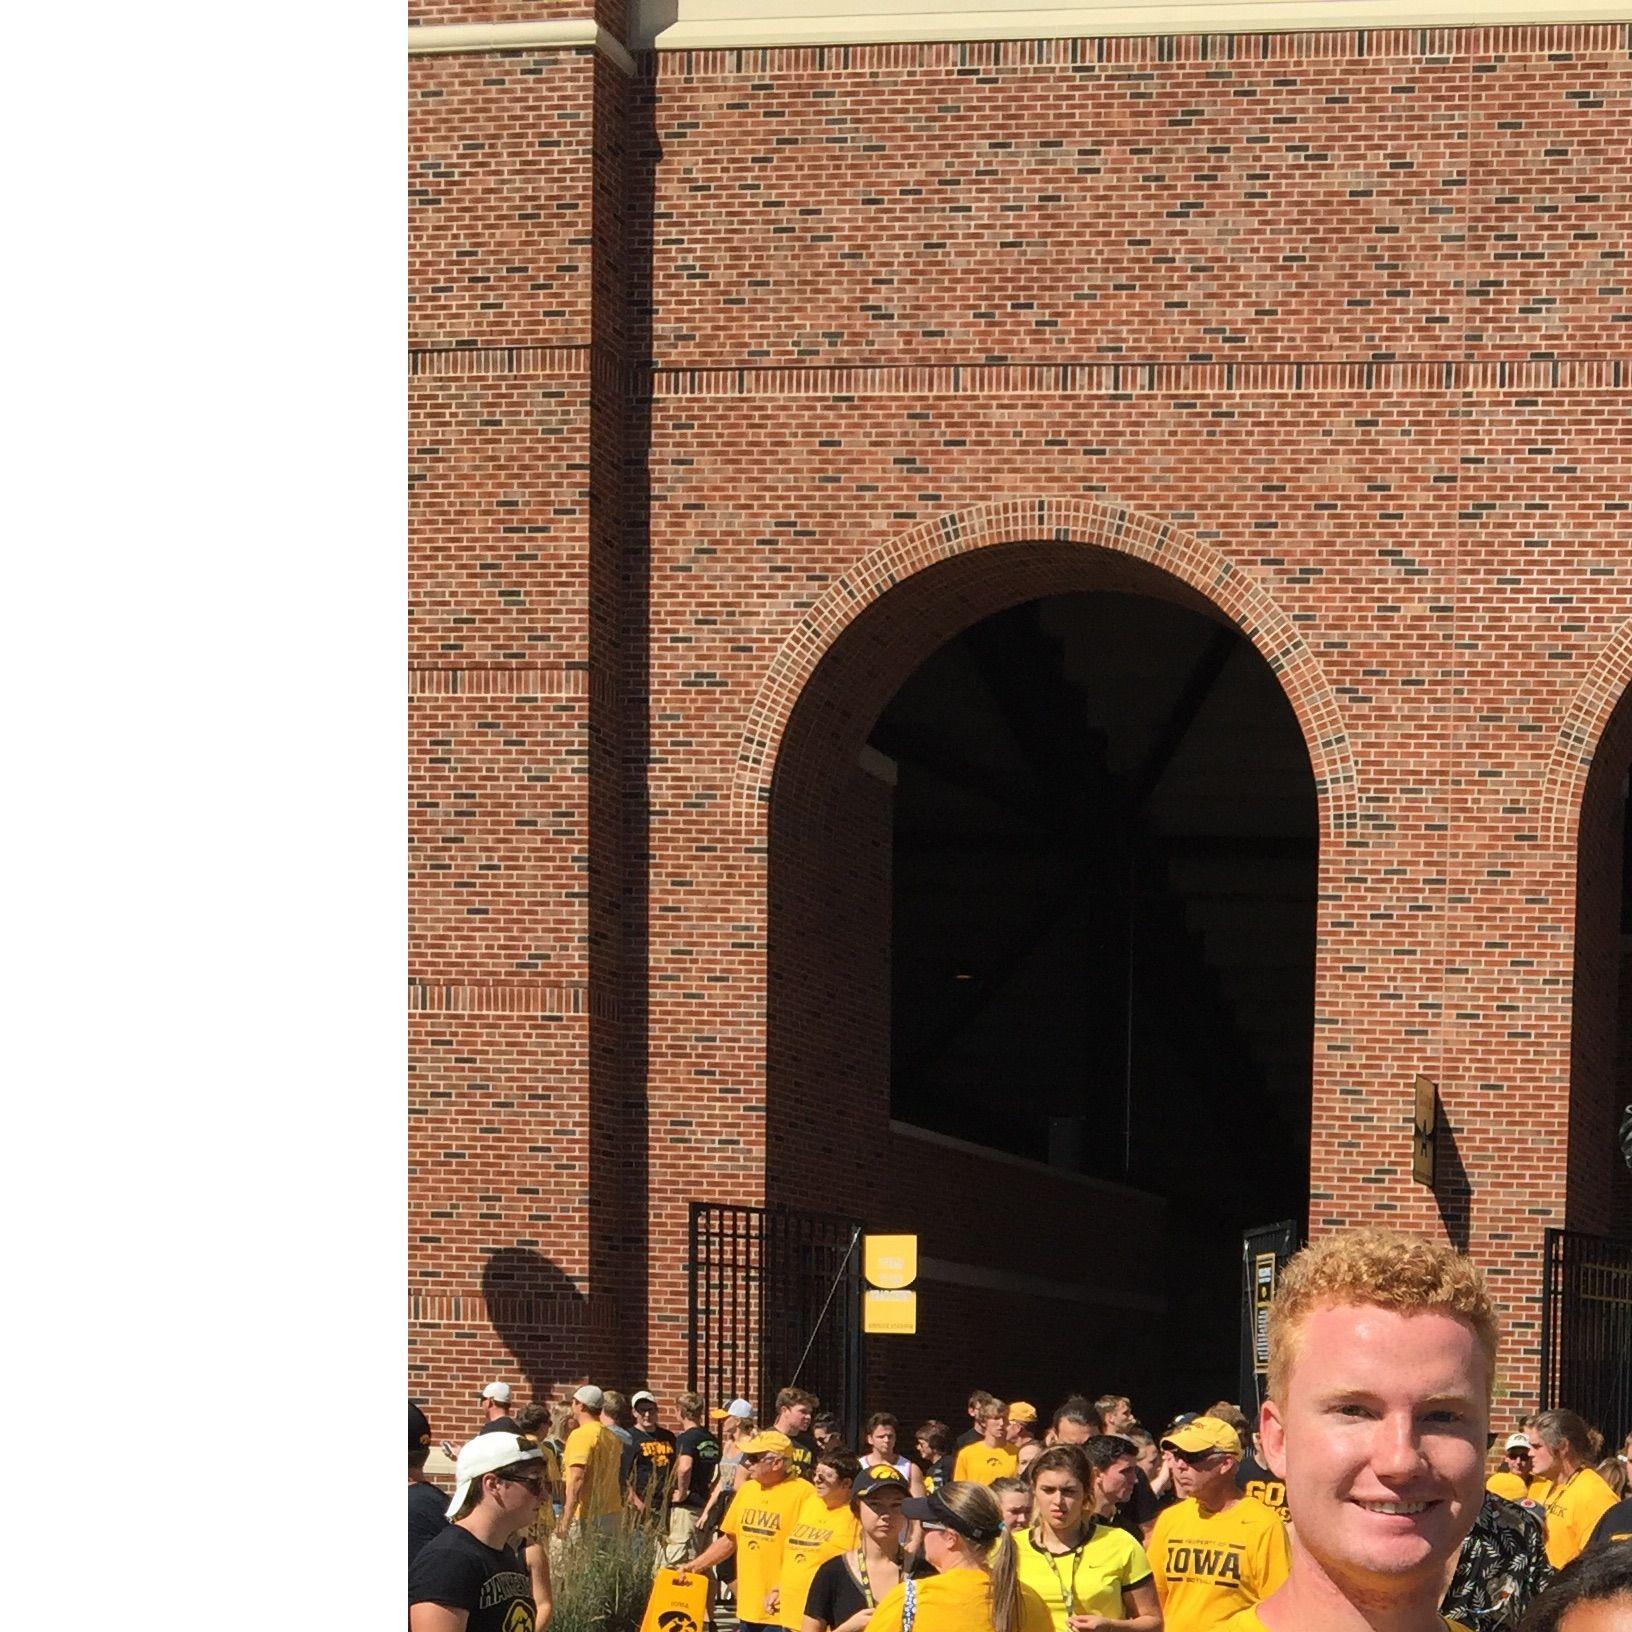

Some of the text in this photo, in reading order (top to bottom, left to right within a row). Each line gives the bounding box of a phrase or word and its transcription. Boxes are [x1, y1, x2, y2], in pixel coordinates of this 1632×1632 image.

[1246, 1480, 1286, 1506] GO
[741, 1508, 781, 1531] IOWA
[792, 1524, 834, 1542] IOWA
[1166, 1548, 1241, 1580] IOWA
